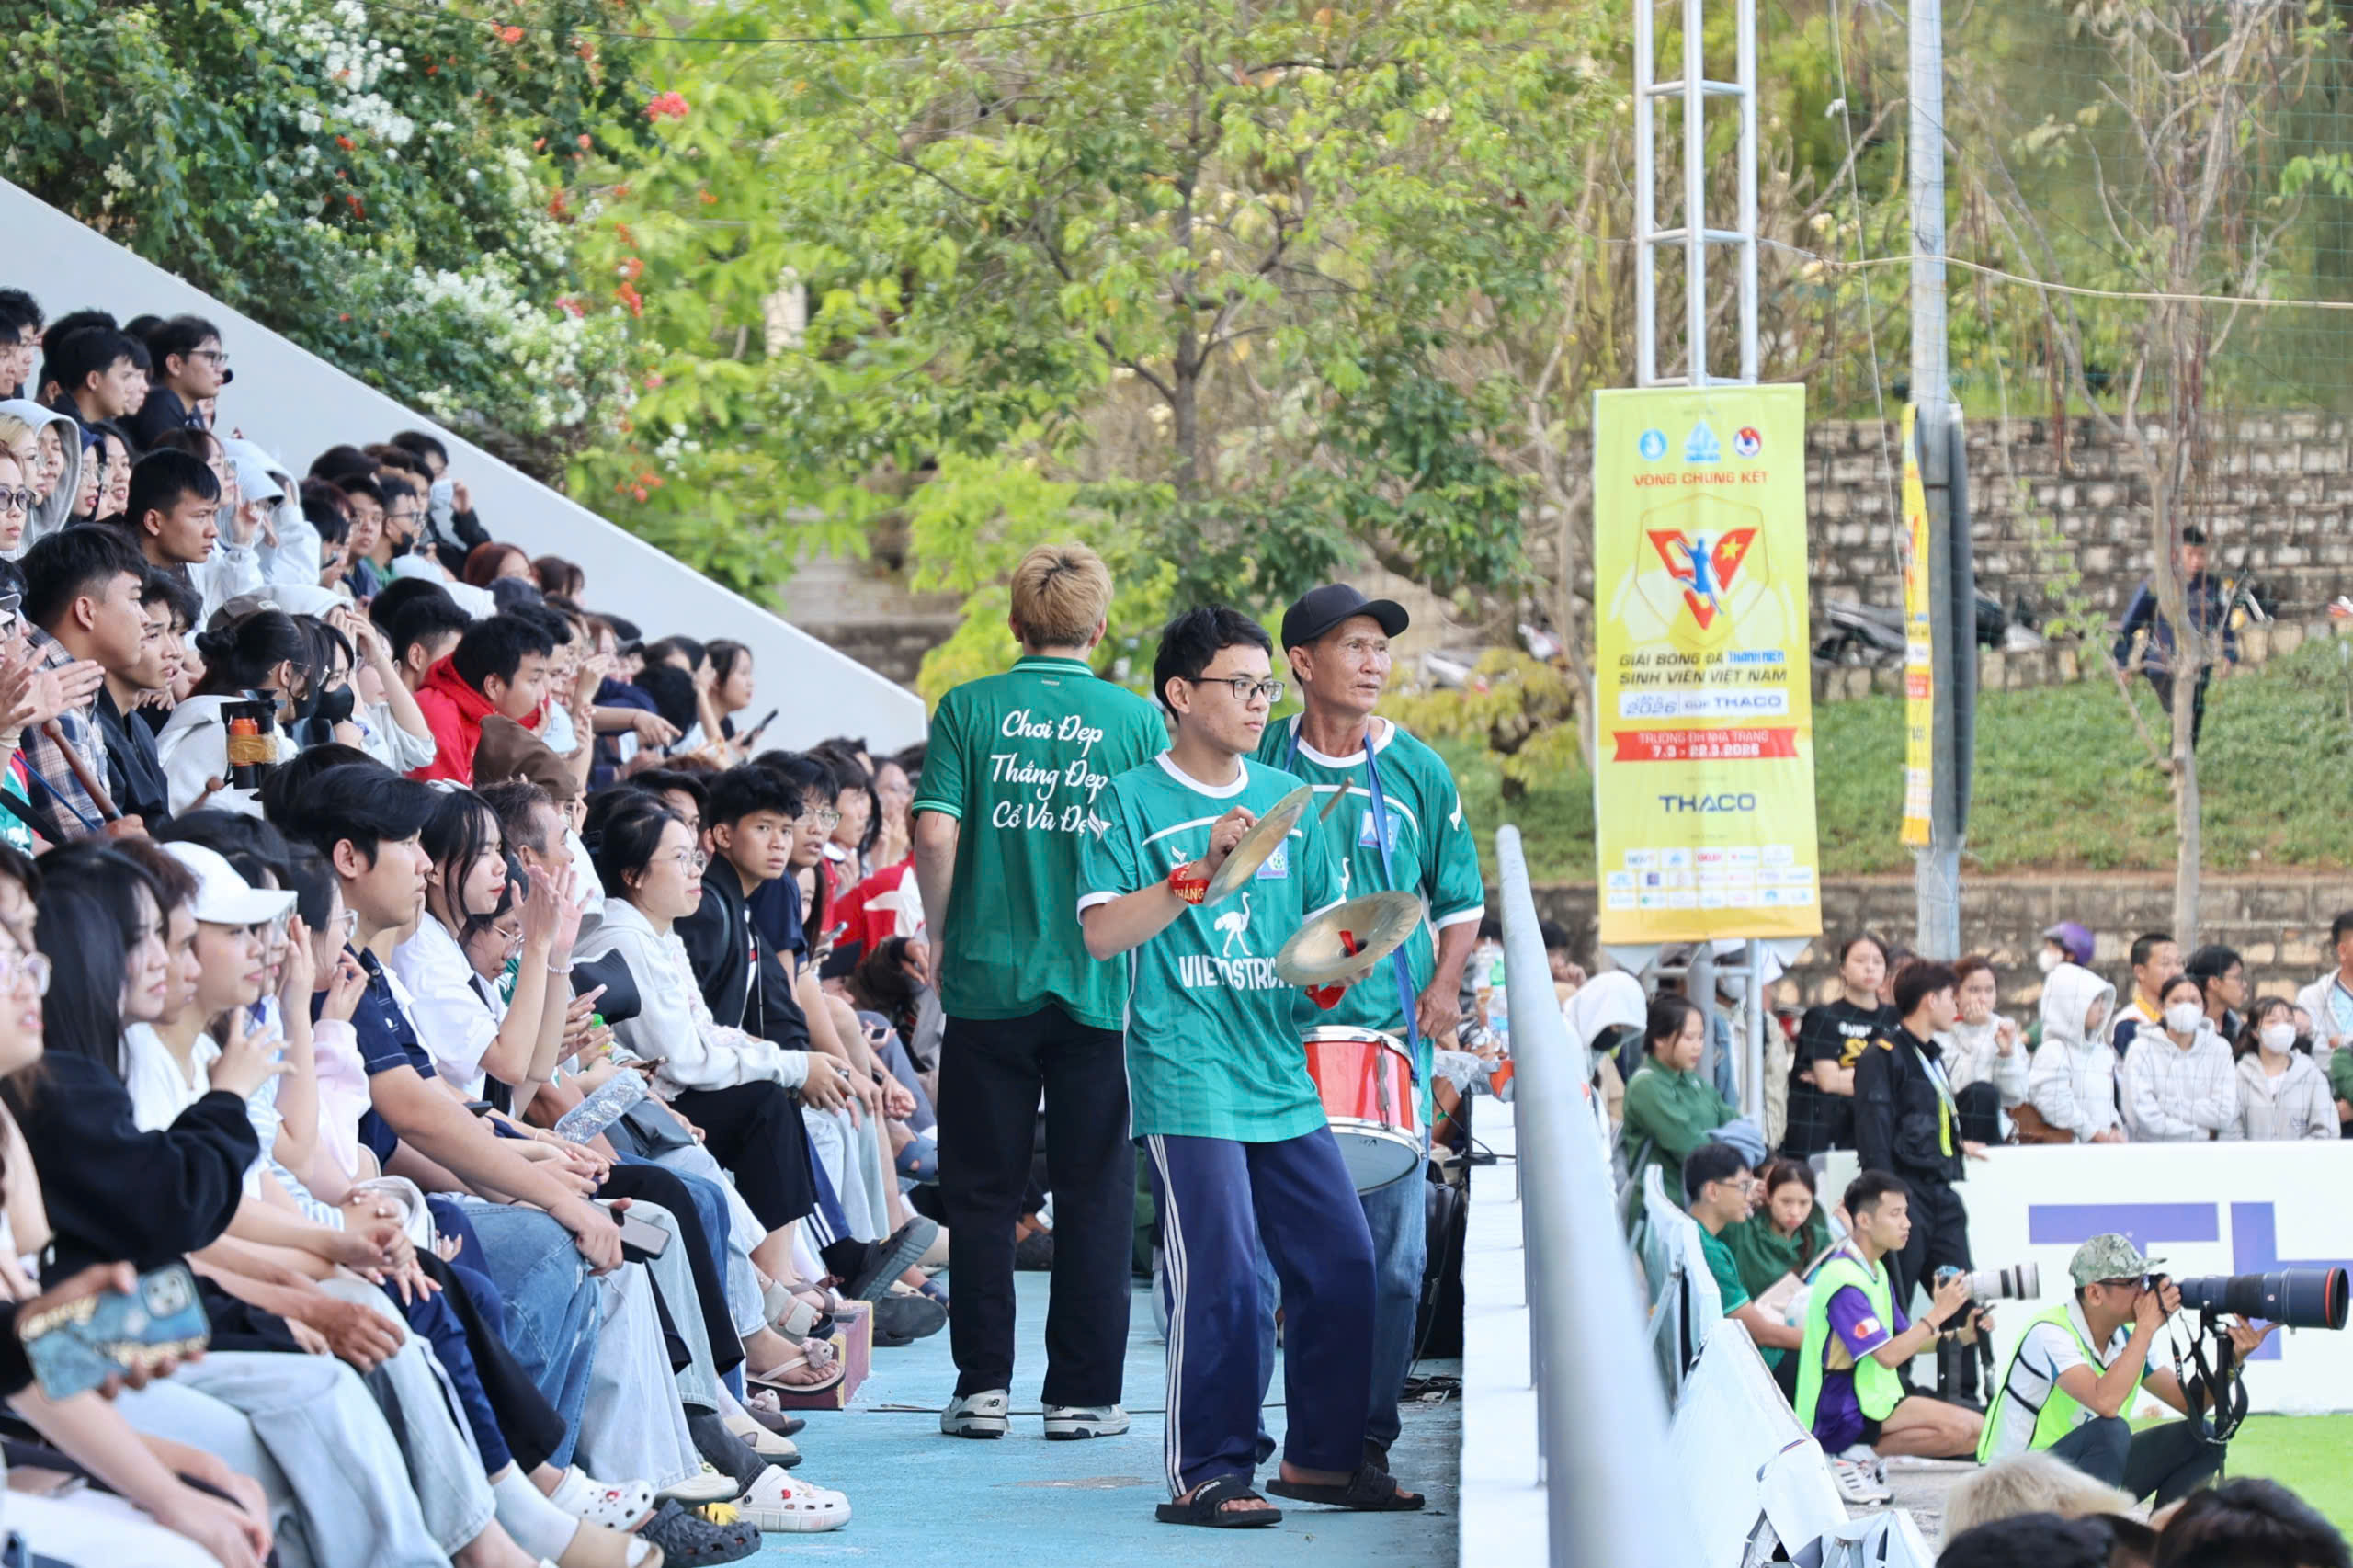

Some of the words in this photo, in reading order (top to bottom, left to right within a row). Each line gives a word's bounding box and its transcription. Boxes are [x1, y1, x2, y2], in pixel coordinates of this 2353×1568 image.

[1682, 470, 1735, 485] CHUNG
[1620, 670, 1660, 685] SINH
[1748, 668, 1788, 683] NAM
[1714, 695, 1781, 709] THACO
[1058, 715, 1103, 757] Đẹp
[990, 752, 1060, 801] Thắng
[1065, 760, 1109, 804] Đẹp
[1658, 793, 1756, 812] THACO
[992, 801, 1023, 829] Cổ
